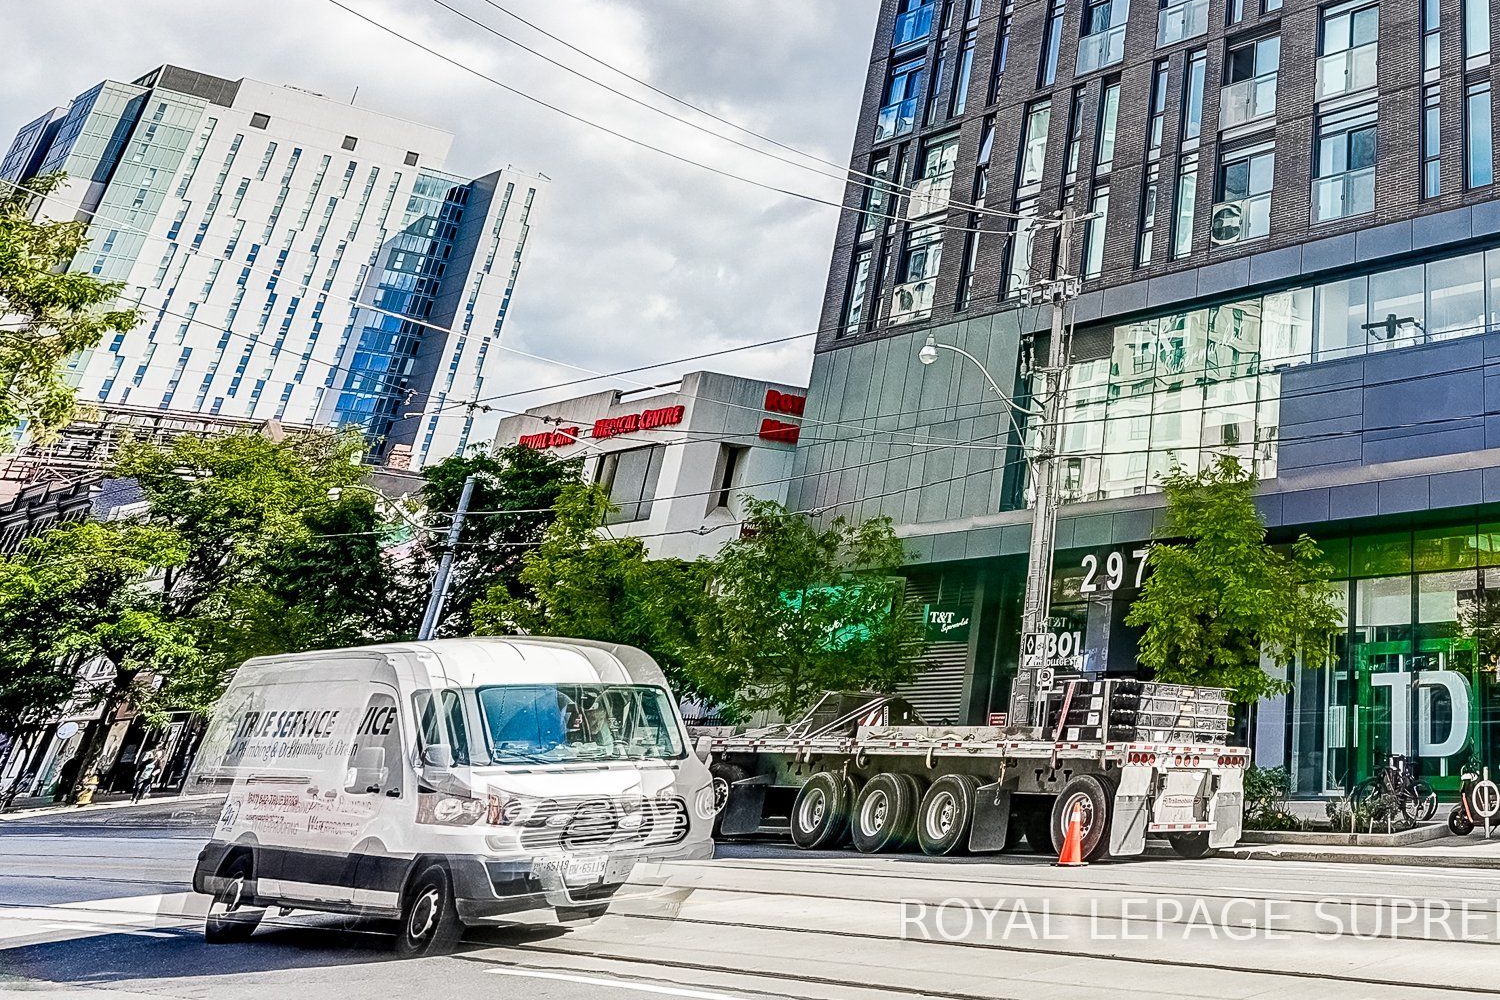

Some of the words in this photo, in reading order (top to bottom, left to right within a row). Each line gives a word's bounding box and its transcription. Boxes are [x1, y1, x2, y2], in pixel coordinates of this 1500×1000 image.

[592, 414, 641, 438] MEDICAL
[639, 405, 685, 429] CENTRE
[1080, 550, 1150, 592] 297
[930, 611, 955, 624] T&T
[1046, 631, 1081, 659] 301
[237, 711, 278, 738] TRUE
[271, 710, 340, 738] SERVICE
[1371, 670, 1470, 758] TD
